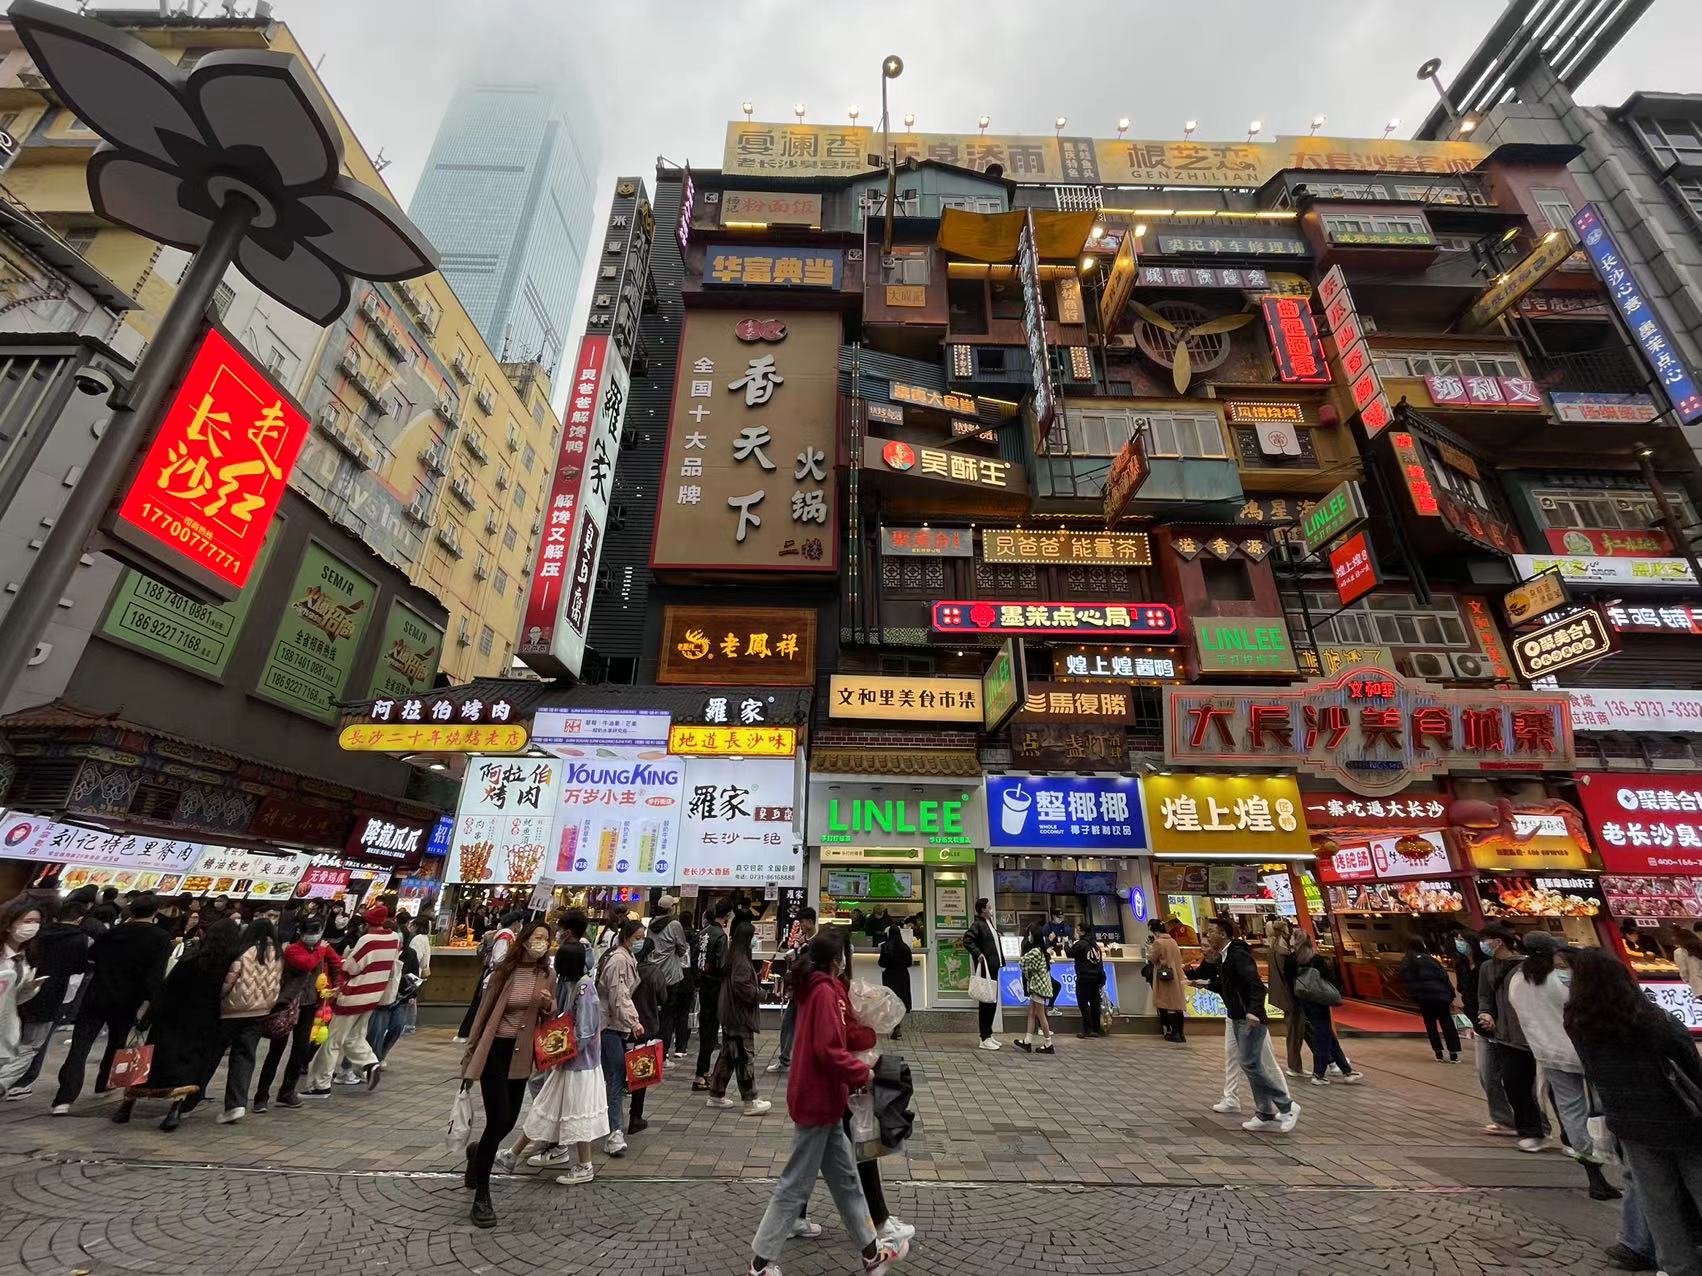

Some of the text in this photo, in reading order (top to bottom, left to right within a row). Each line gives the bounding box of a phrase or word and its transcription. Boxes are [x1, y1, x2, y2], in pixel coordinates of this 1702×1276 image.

[1131, 169, 1260, 183] GENZHILIAN
[712, 255, 835, 284] 华富典当
[677, 356, 715, 506] 全国十大品牌
[728, 354, 785, 543] 香天下
[790, 446, 828, 524] 火锅
[1303, 492, 1348, 538] LINLEE
[1072, 537, 1139, 559] 能量茶
[1178, 537, 1266, 555] 溢香源
[144, 580, 162, 600] 188
[189, 601, 213, 624] 0881
[1000, 605, 1131, 628] 墨茉点心局
[130, 610, 202, 652] 186 9227 7168
[295, 629, 338, 662] 全省招商热线
[1201, 626, 1287, 652] LINLEE
[280, 647, 295, 663] 188
[310, 656, 328, 677] 0881
[271, 672, 320, 700] 186 9227 7168
[837, 687, 976, 710] 文和里美食市集
[1348, 680, 1395, 698] 文和里
[371, 699, 512, 721] 阿拉伯烤肉
[705, 697, 765, 724] 羅家
[479, 762, 553, 786] 阿拉伯
[479, 781, 541, 810] 烤肉
[564, 788, 638, 806] 万岁小主
[686, 784, 752, 821] 羅家
[1035, 790, 1131, 822] 整椰椰
[829, 798, 965, 834] LINLEE
[1160, 794, 1277, 833] 煌上煌
[49, 828, 194, 862] 刘记特色里脊肉
[701, 831, 782, 845] 长沙一绝
